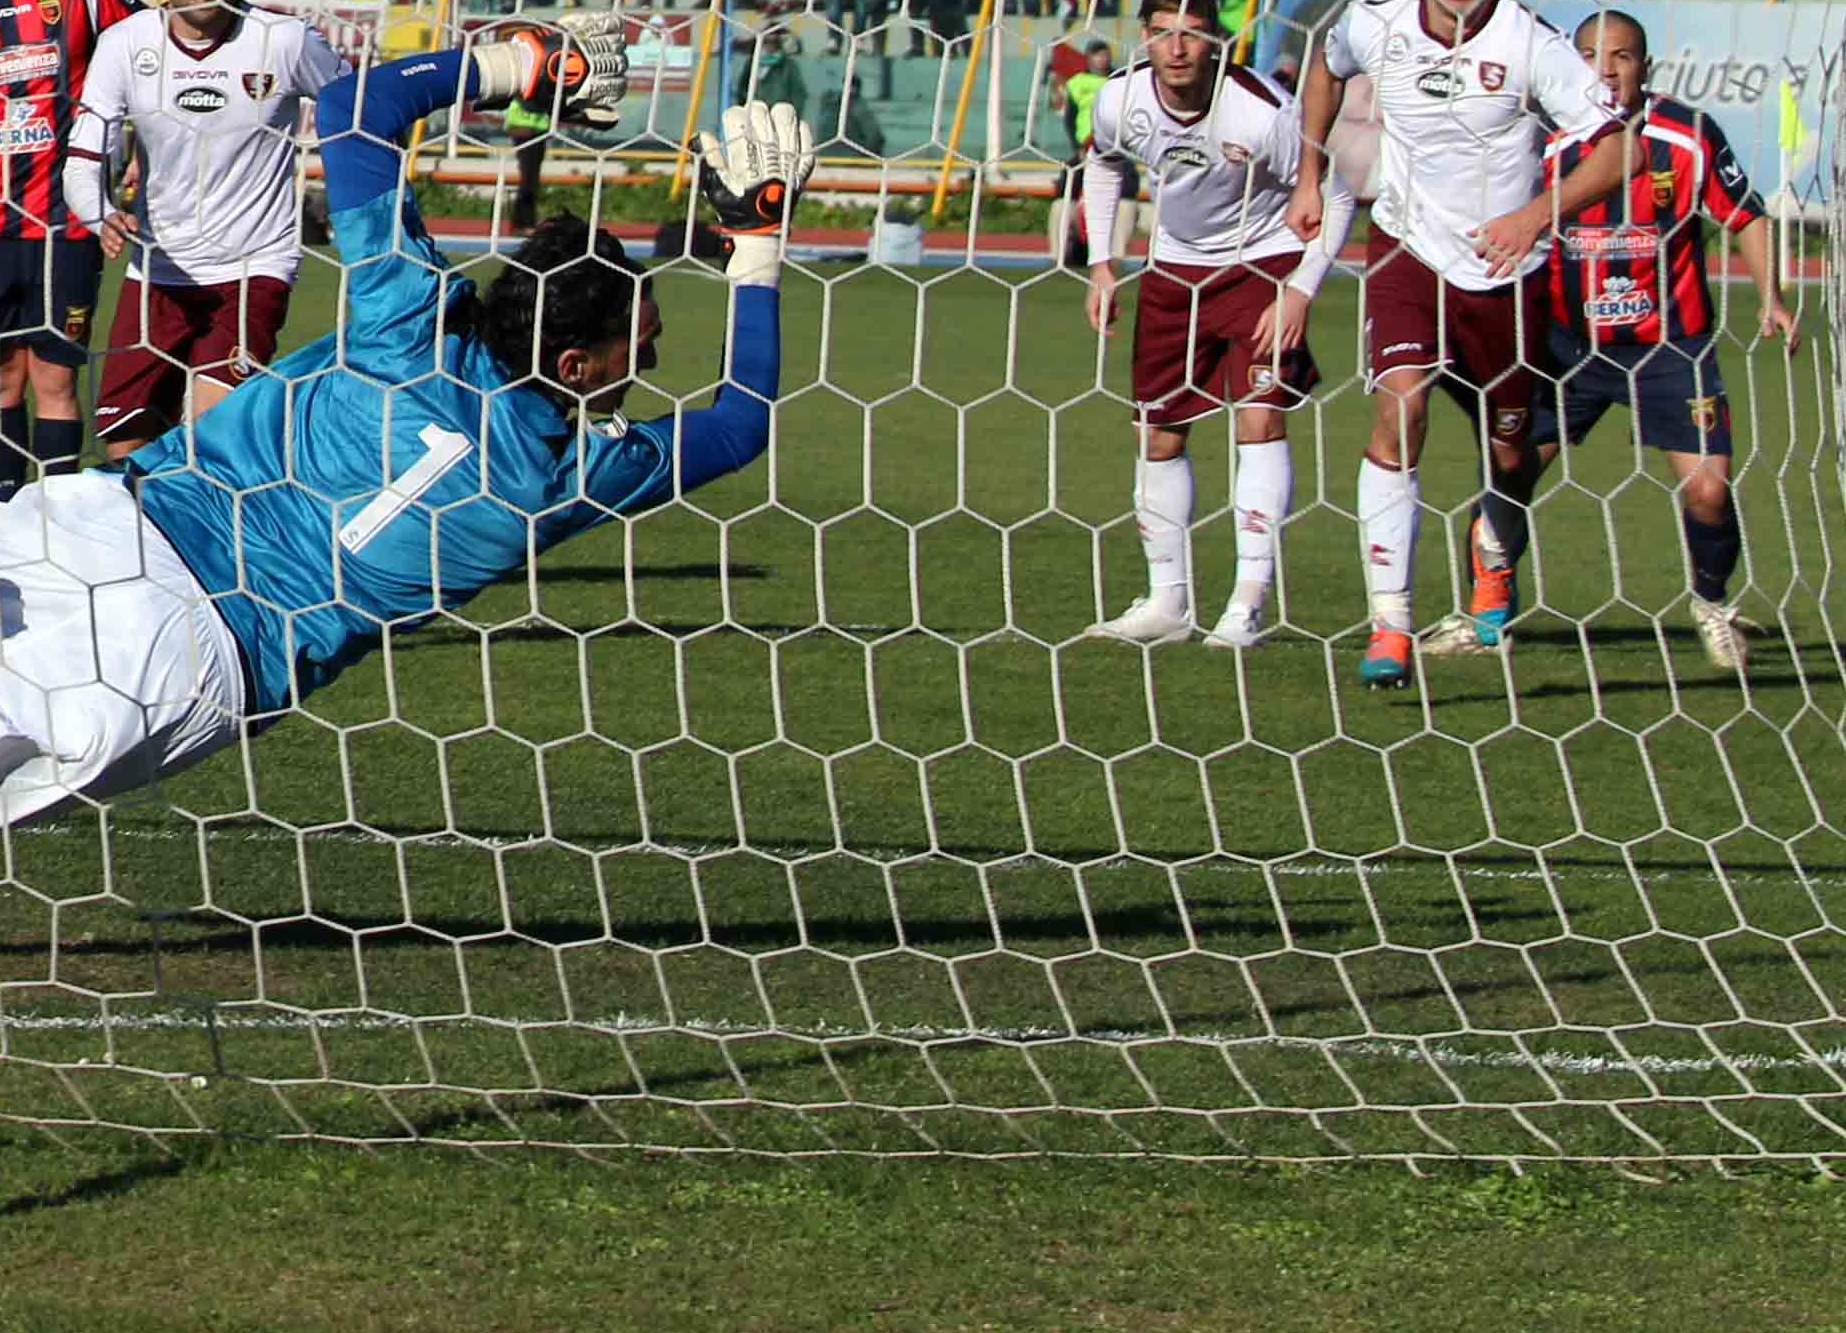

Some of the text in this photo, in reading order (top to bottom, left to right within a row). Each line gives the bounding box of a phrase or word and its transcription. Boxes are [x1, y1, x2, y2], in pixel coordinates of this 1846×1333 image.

[172, 70, 229, 81] GIVOVA
[178, 94, 227, 108] motta
[338, 422, 474, 555] 1
